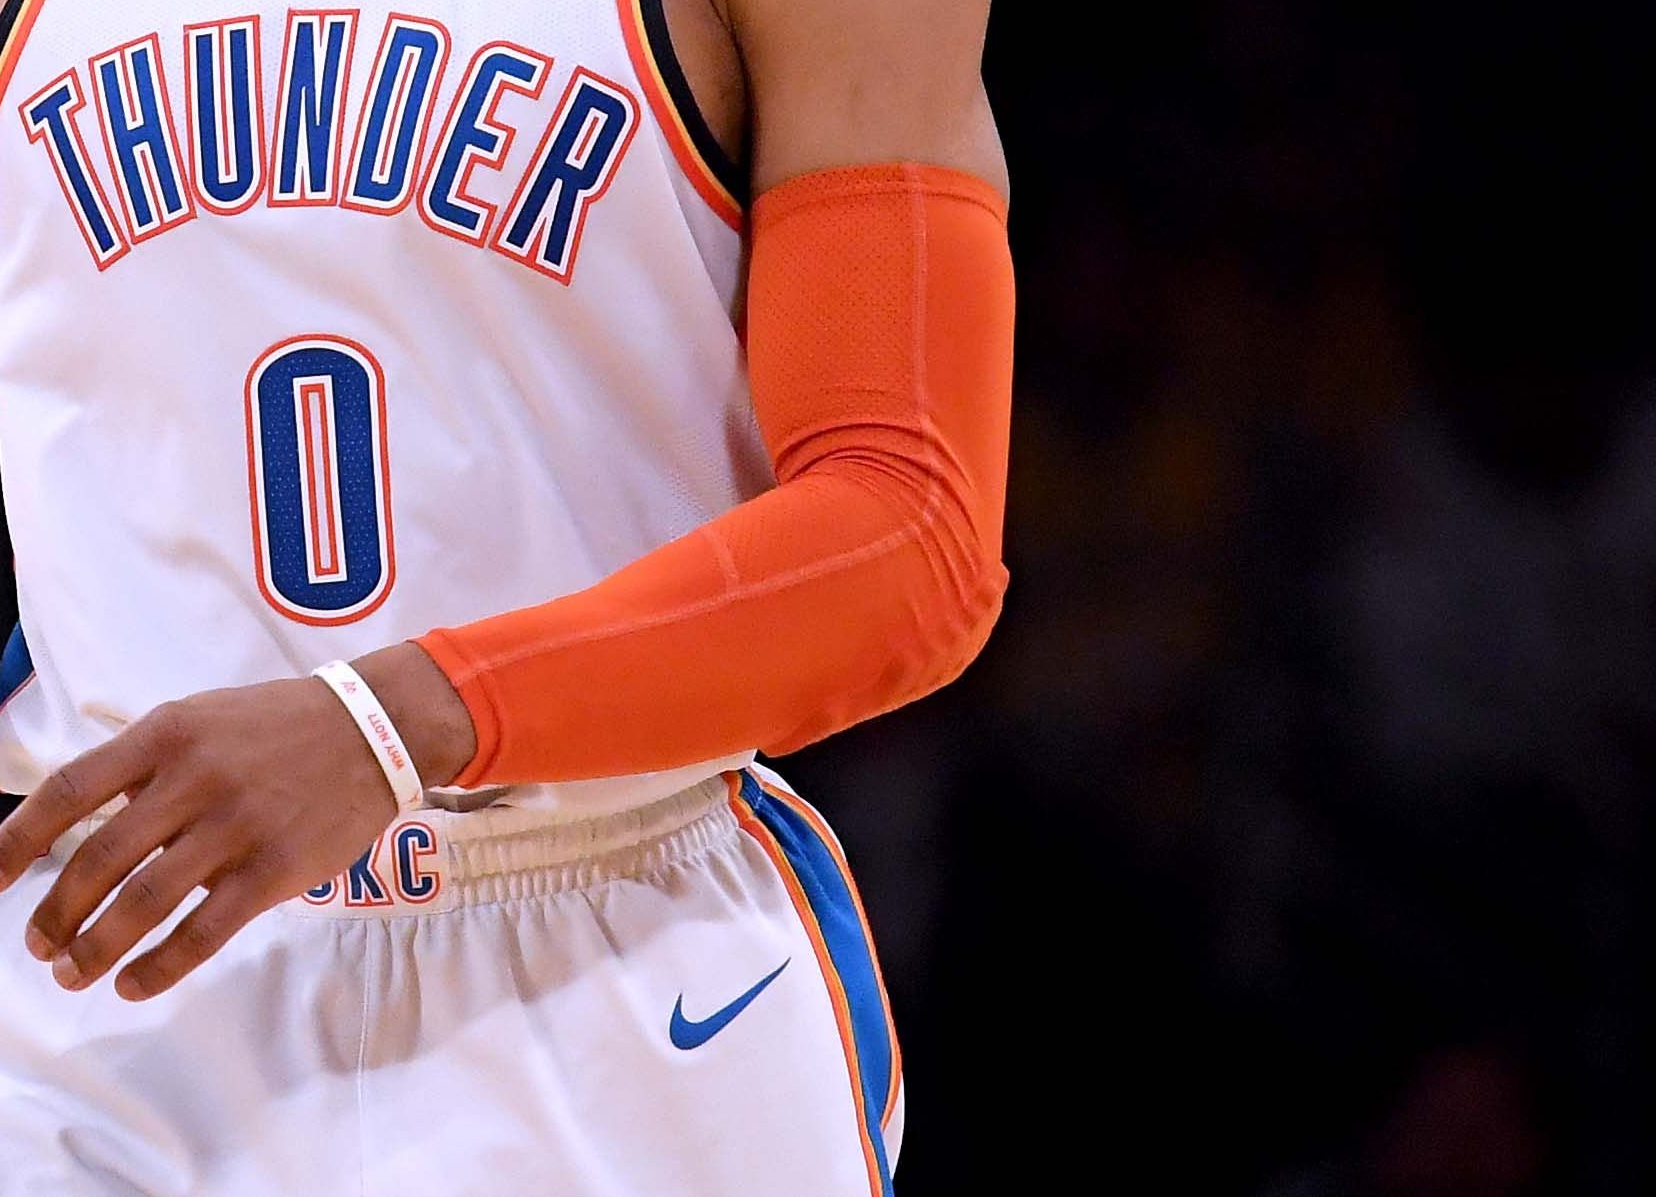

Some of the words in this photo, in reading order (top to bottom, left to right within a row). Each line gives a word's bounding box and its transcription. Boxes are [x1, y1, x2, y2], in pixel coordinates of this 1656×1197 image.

[18, 9, 640, 286] THUNDER
[244, 335, 396, 627] 0
[368, 713, 391, 742] NOT?
[384, 744, 405, 771] WHY
[300, 821, 440, 907] KC
